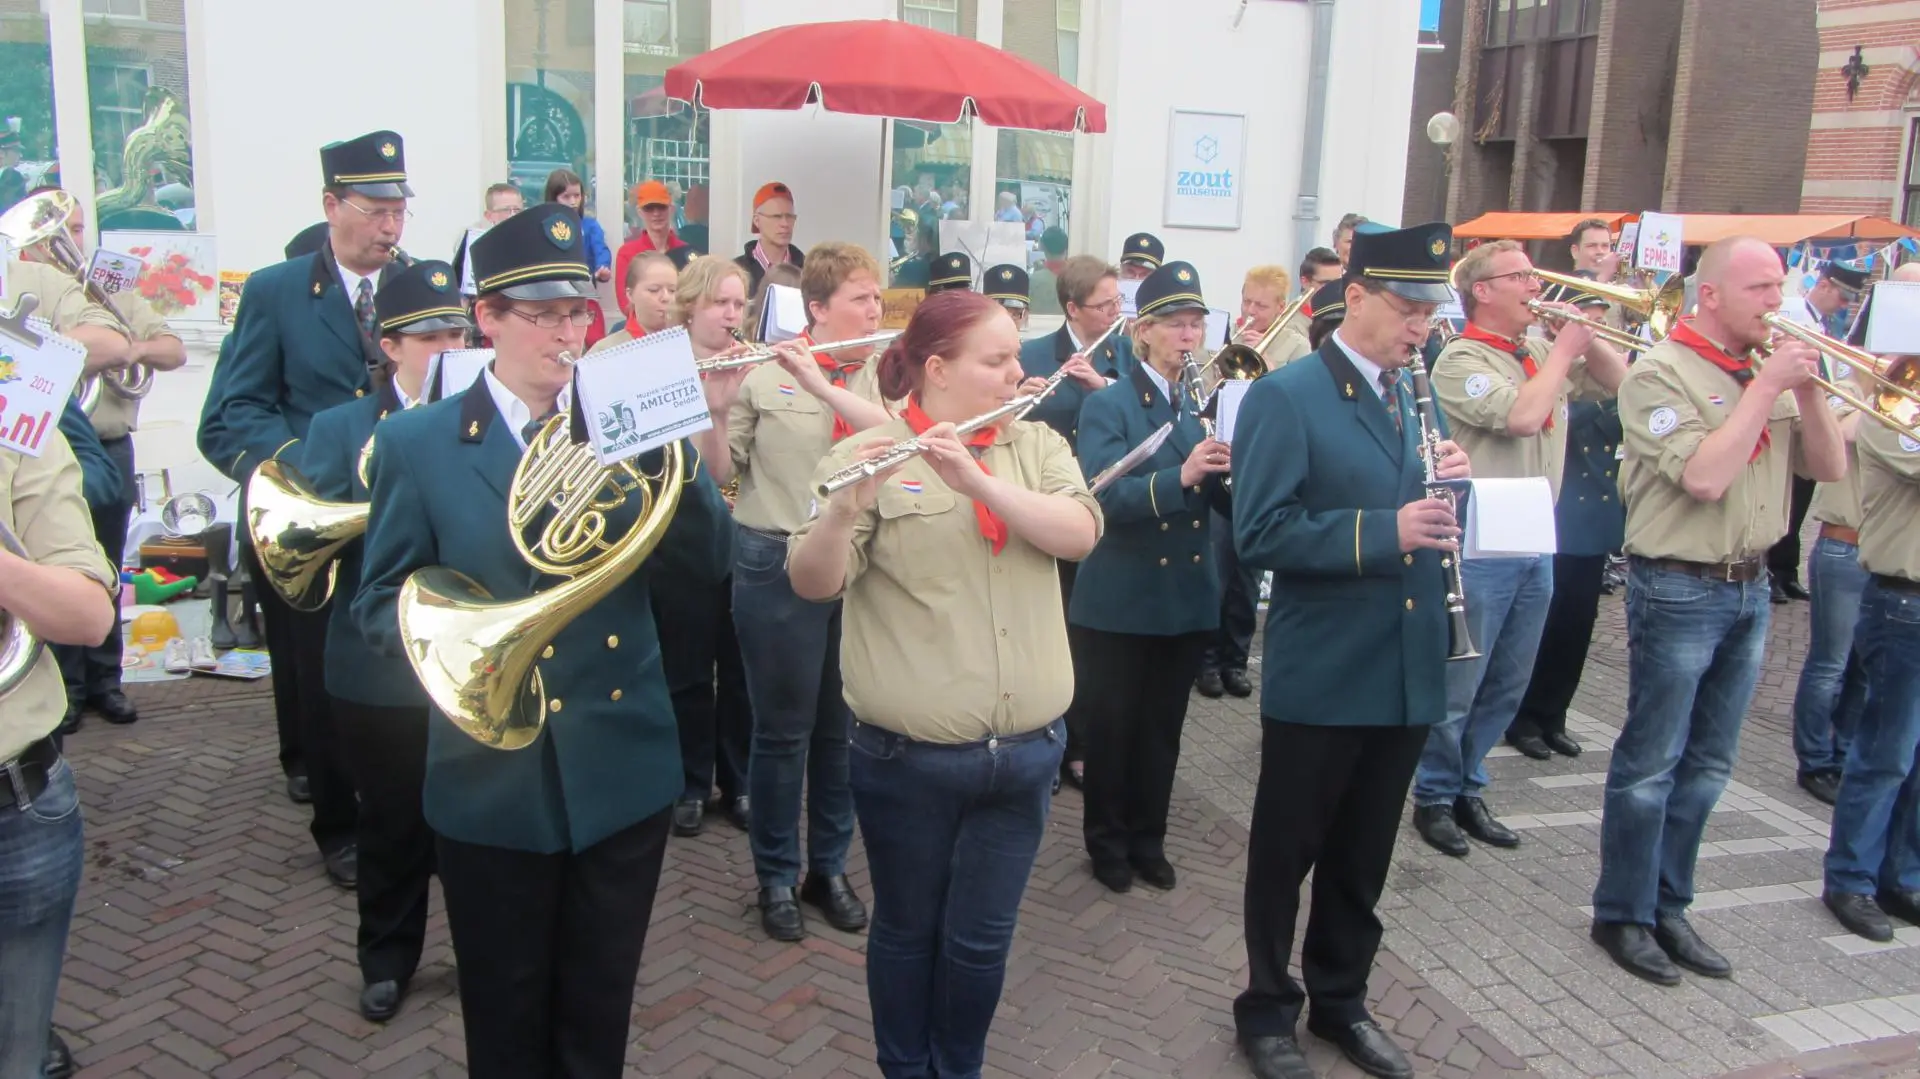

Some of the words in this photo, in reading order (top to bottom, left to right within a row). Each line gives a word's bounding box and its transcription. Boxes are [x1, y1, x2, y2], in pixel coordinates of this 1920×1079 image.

[1177, 167, 1232, 188] zout
[1177, 187, 1231, 197] museum
[1644, 247, 1679, 270] EPMB.nl
[30, 375, 55, 395] 2011
[640, 384, 698, 412] AMICITIA
[673, 394, 701, 408] Delden
